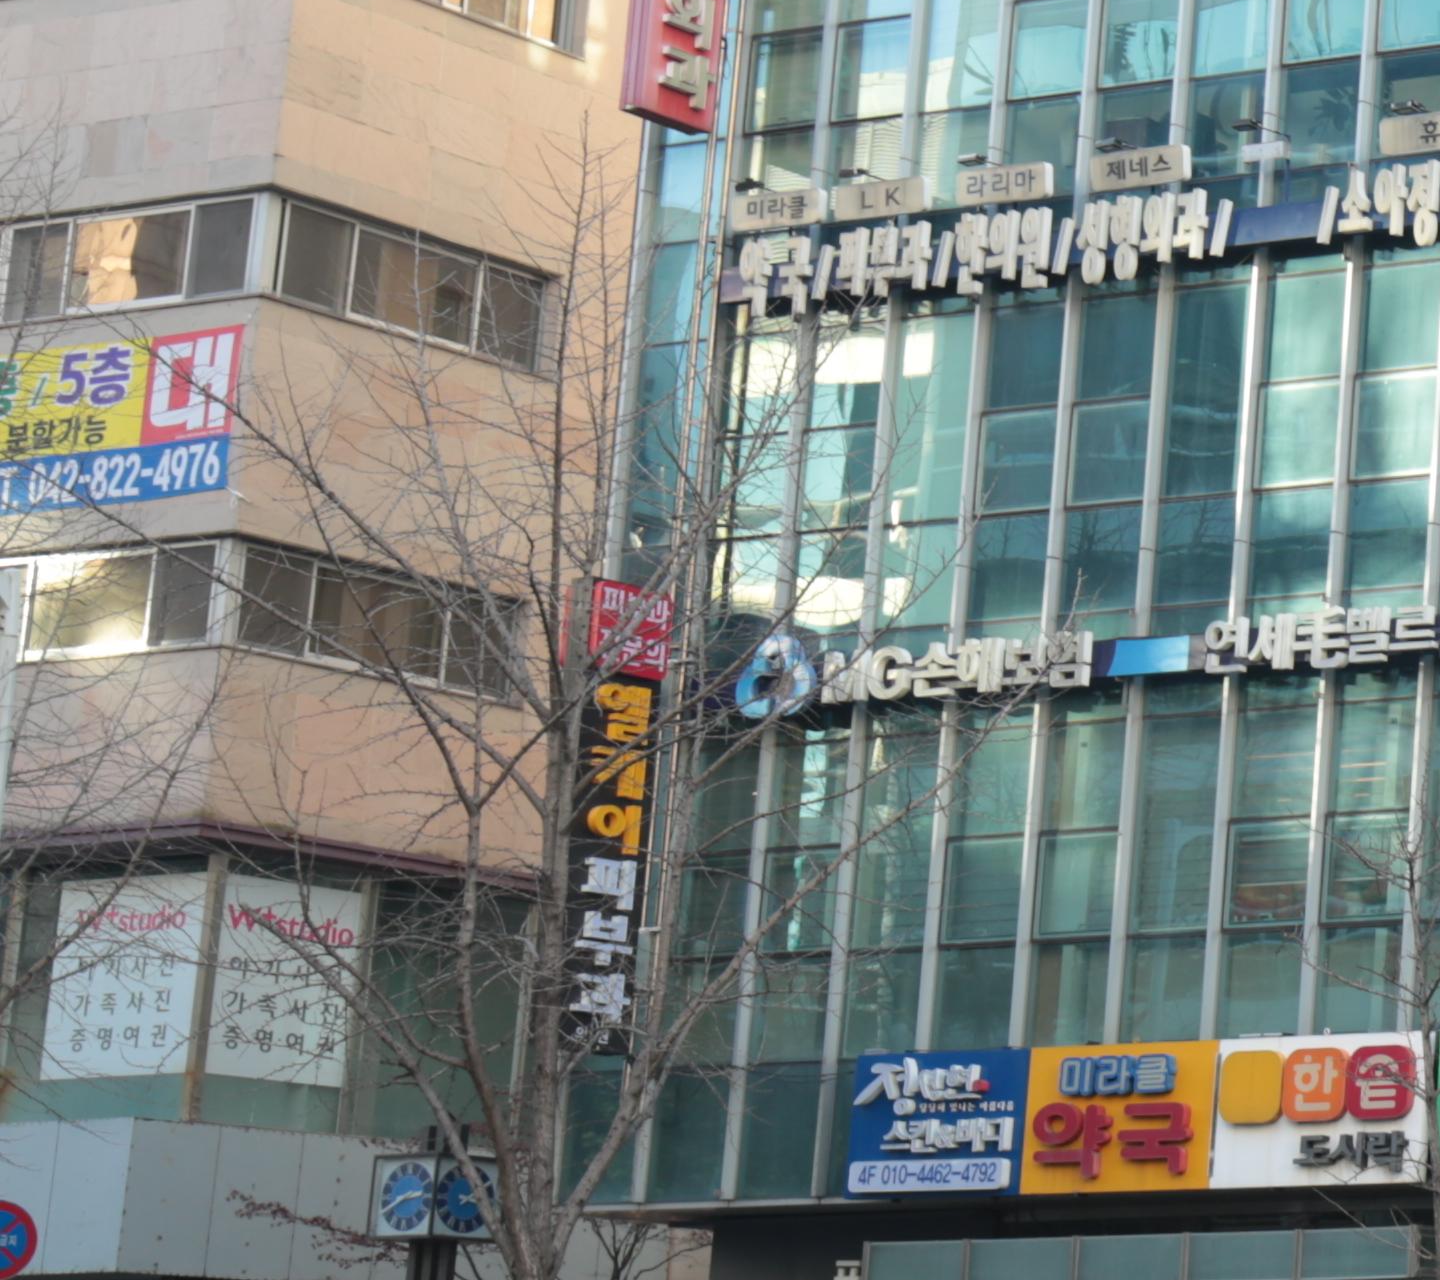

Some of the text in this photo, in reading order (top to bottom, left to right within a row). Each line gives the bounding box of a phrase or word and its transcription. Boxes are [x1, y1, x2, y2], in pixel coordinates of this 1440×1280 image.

[966, 174, 1036, 199] 라리마
[1106, 154, 1171, 178] 제네스
[746, 195, 808, 221] 미라클
[56, 332, 236, 431] 5층 대
[6, 415, 107, 455] 분할가능
[29, 442, 220, 504] 042-822-4976
[821, 630, 1094, 703] MG손해보험
[73, 989, 172, 1018] 가족사진
[1059, 1054, 1178, 1097] 미라클
[1032, 1101, 1194, 1179] 약국
[1293, 1131, 1409, 1173] 도시락
[858, 1162, 997, 1185] 4F 010-4462-4792
